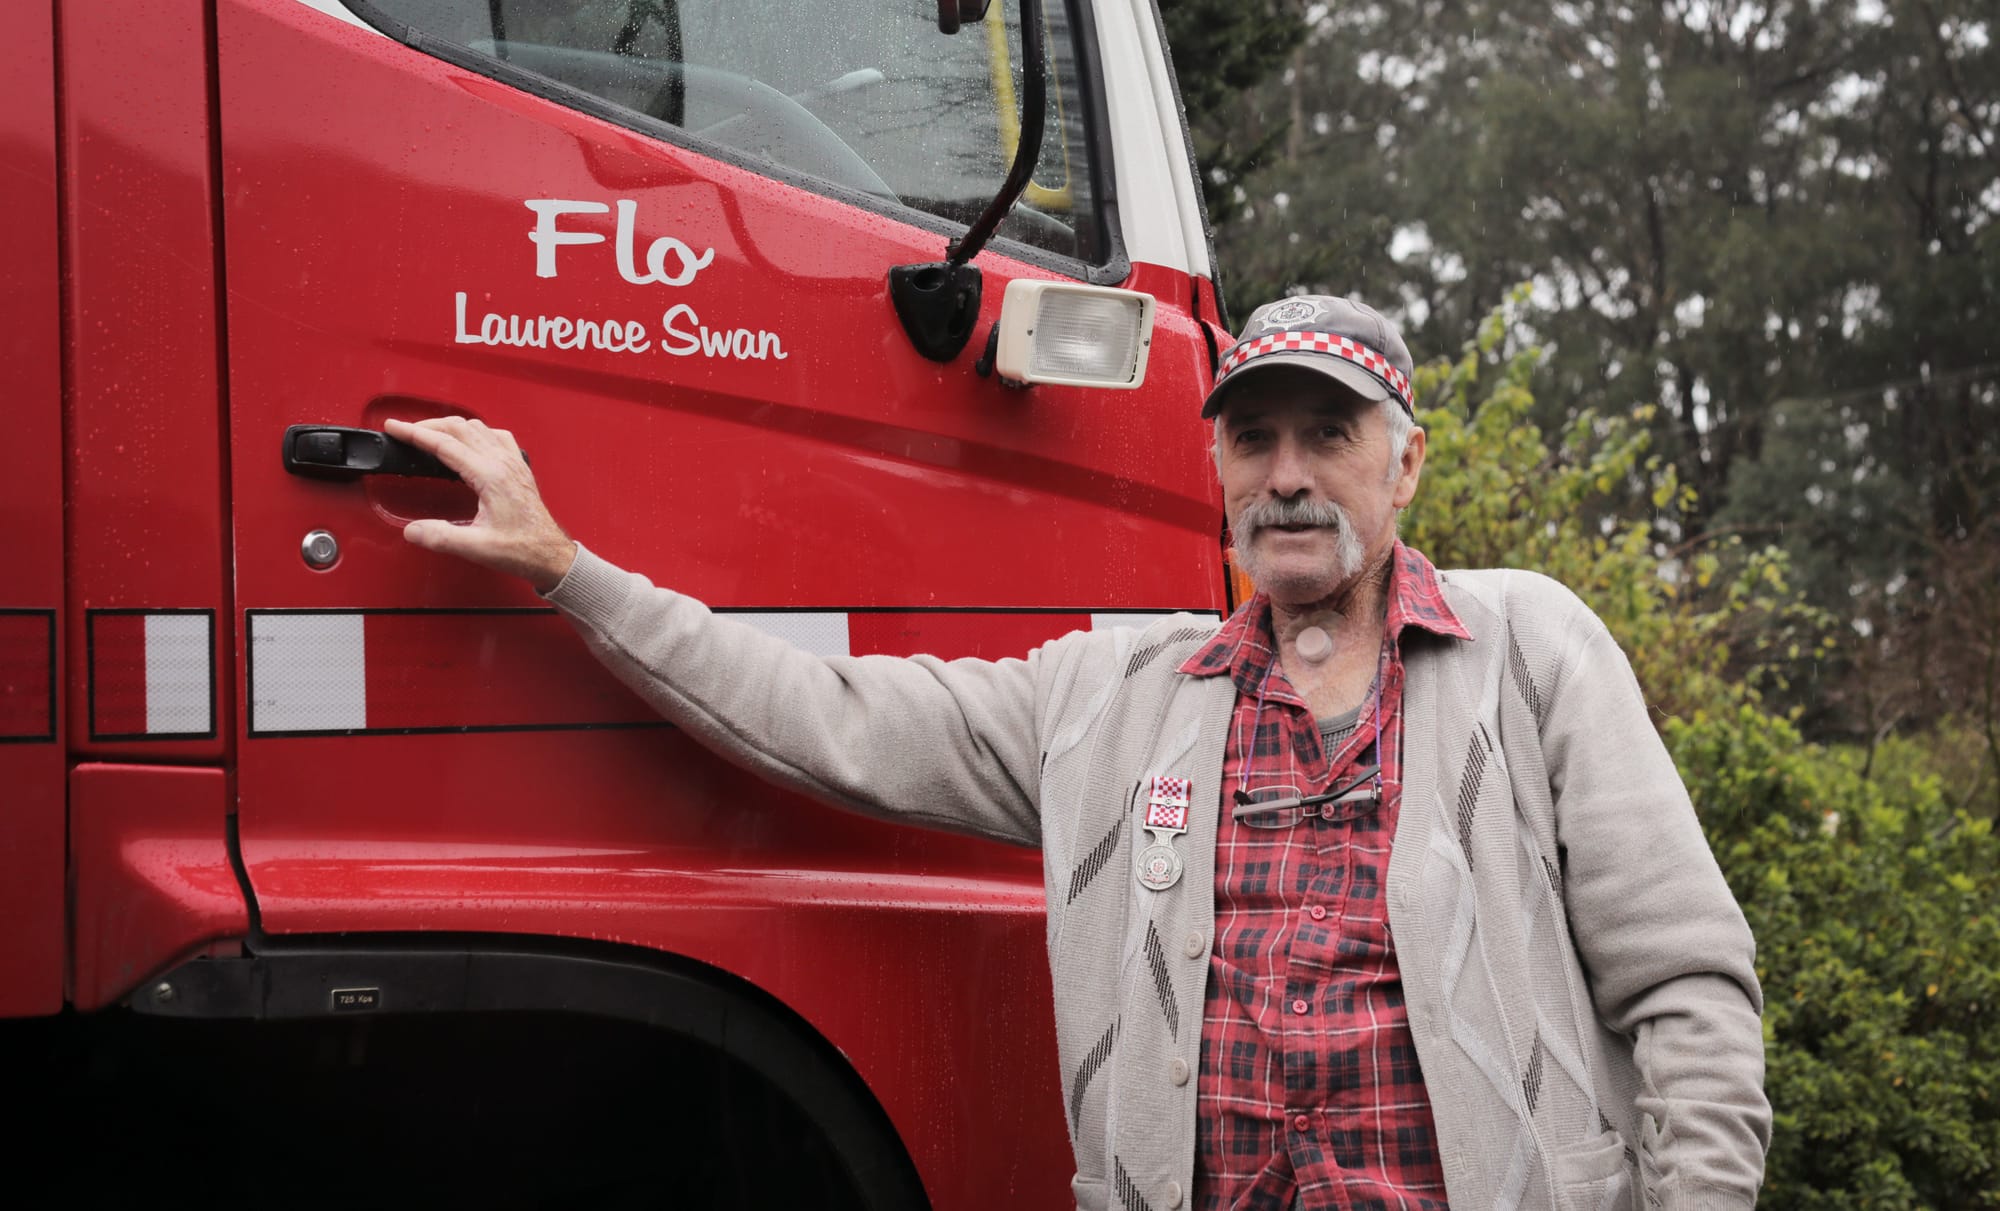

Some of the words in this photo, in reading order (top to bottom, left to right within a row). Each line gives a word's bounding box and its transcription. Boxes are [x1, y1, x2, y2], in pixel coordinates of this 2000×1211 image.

[524, 198, 715, 287] Flo
[455, 291, 651, 354] Laurence
[661, 303, 788, 360] Swan
[340, 995, 355, 1004] 725
